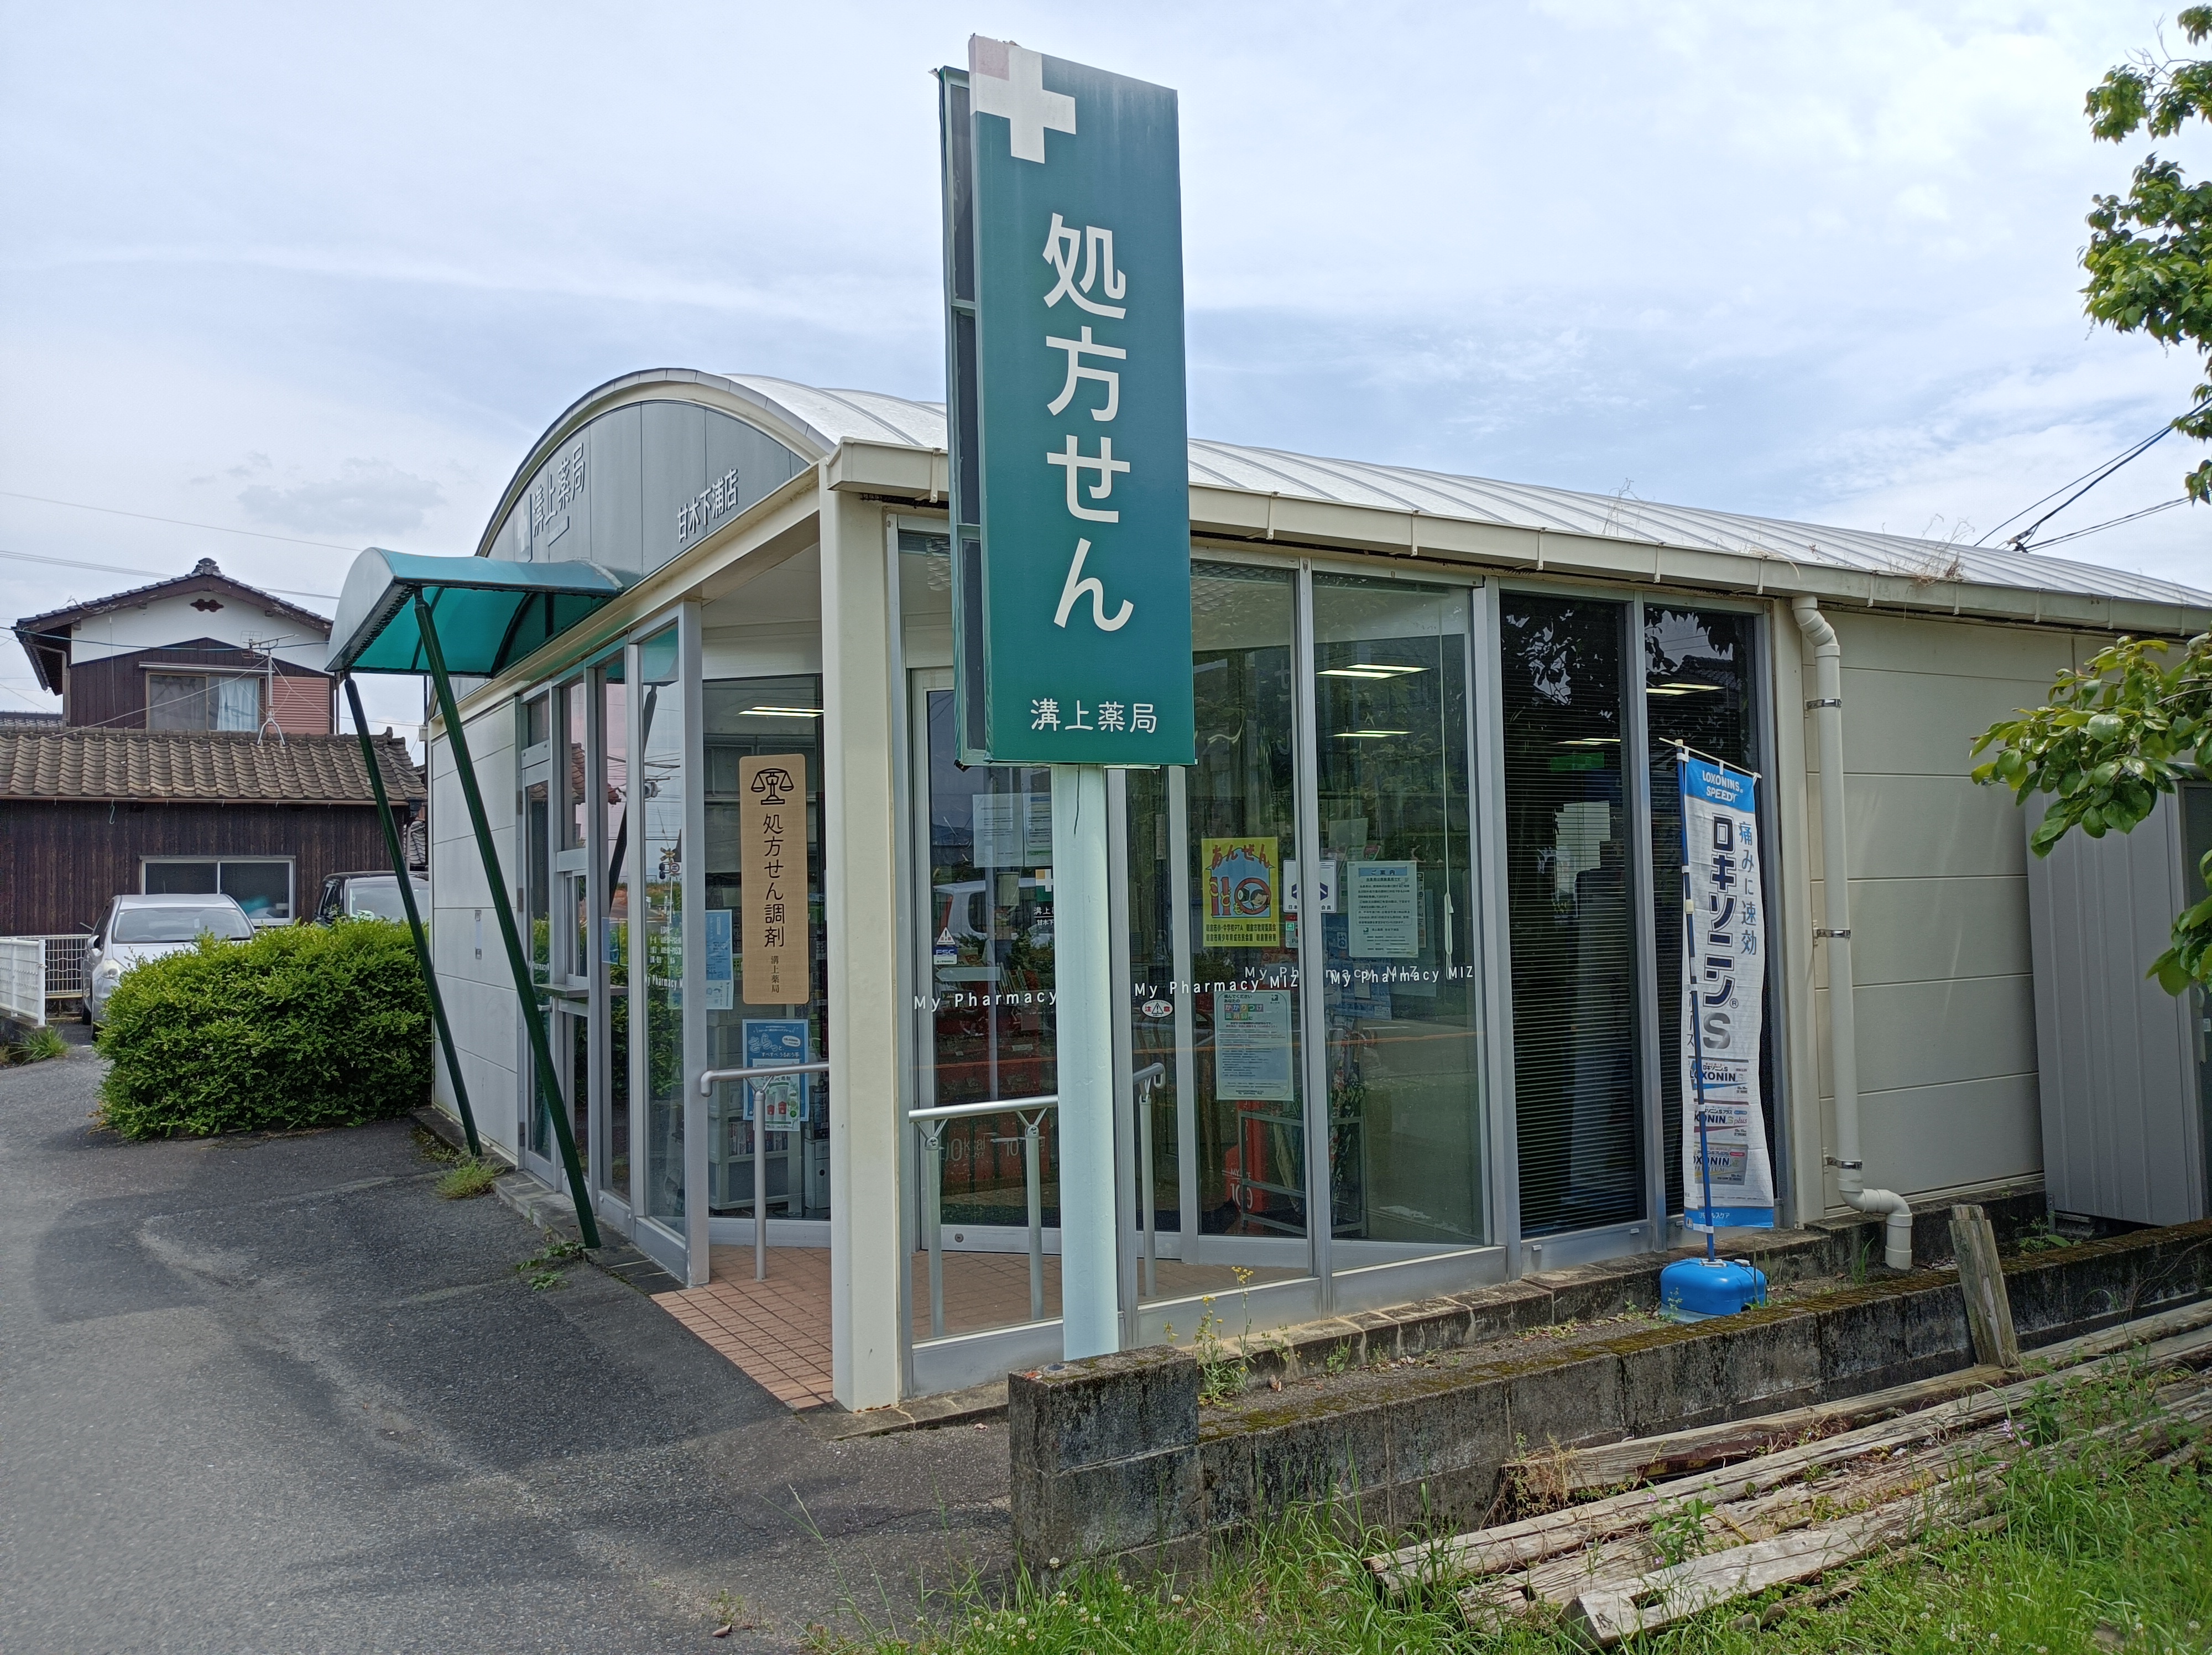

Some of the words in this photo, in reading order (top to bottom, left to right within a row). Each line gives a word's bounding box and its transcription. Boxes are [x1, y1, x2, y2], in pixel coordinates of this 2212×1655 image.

[1042, 212, 1134, 632] 処方せん
[533, 443, 586, 538] 溝上薬局
[677, 468, 739, 543] 甘木下浦店
[1030, 698, 1157, 734] 溝上薬局
[1706, 785, 1738, 803] SPEEDY
[1212, 844, 1270, 870] あんぜん
[762, 813, 785, 948] 処方せん調剤
[1738, 821, 1757, 956] 痛みに速効
[652, 974, 677, 991] Pharmacy
[770, 955, 780, 994] 溝上薬局
[1134, 983, 1159, 999] My
[1170, 977, 1259, 994] Pharmacy
[1270, 975, 1298, 989] MIZ
[1331, 973, 1352, 988] My
[1361, 967, 1440, 983] Pharmacy
[1449, 966, 1474, 979] MIZ
[914, 995, 941, 1012] My
[955, 992, 1057, 1008] Pharmacy
